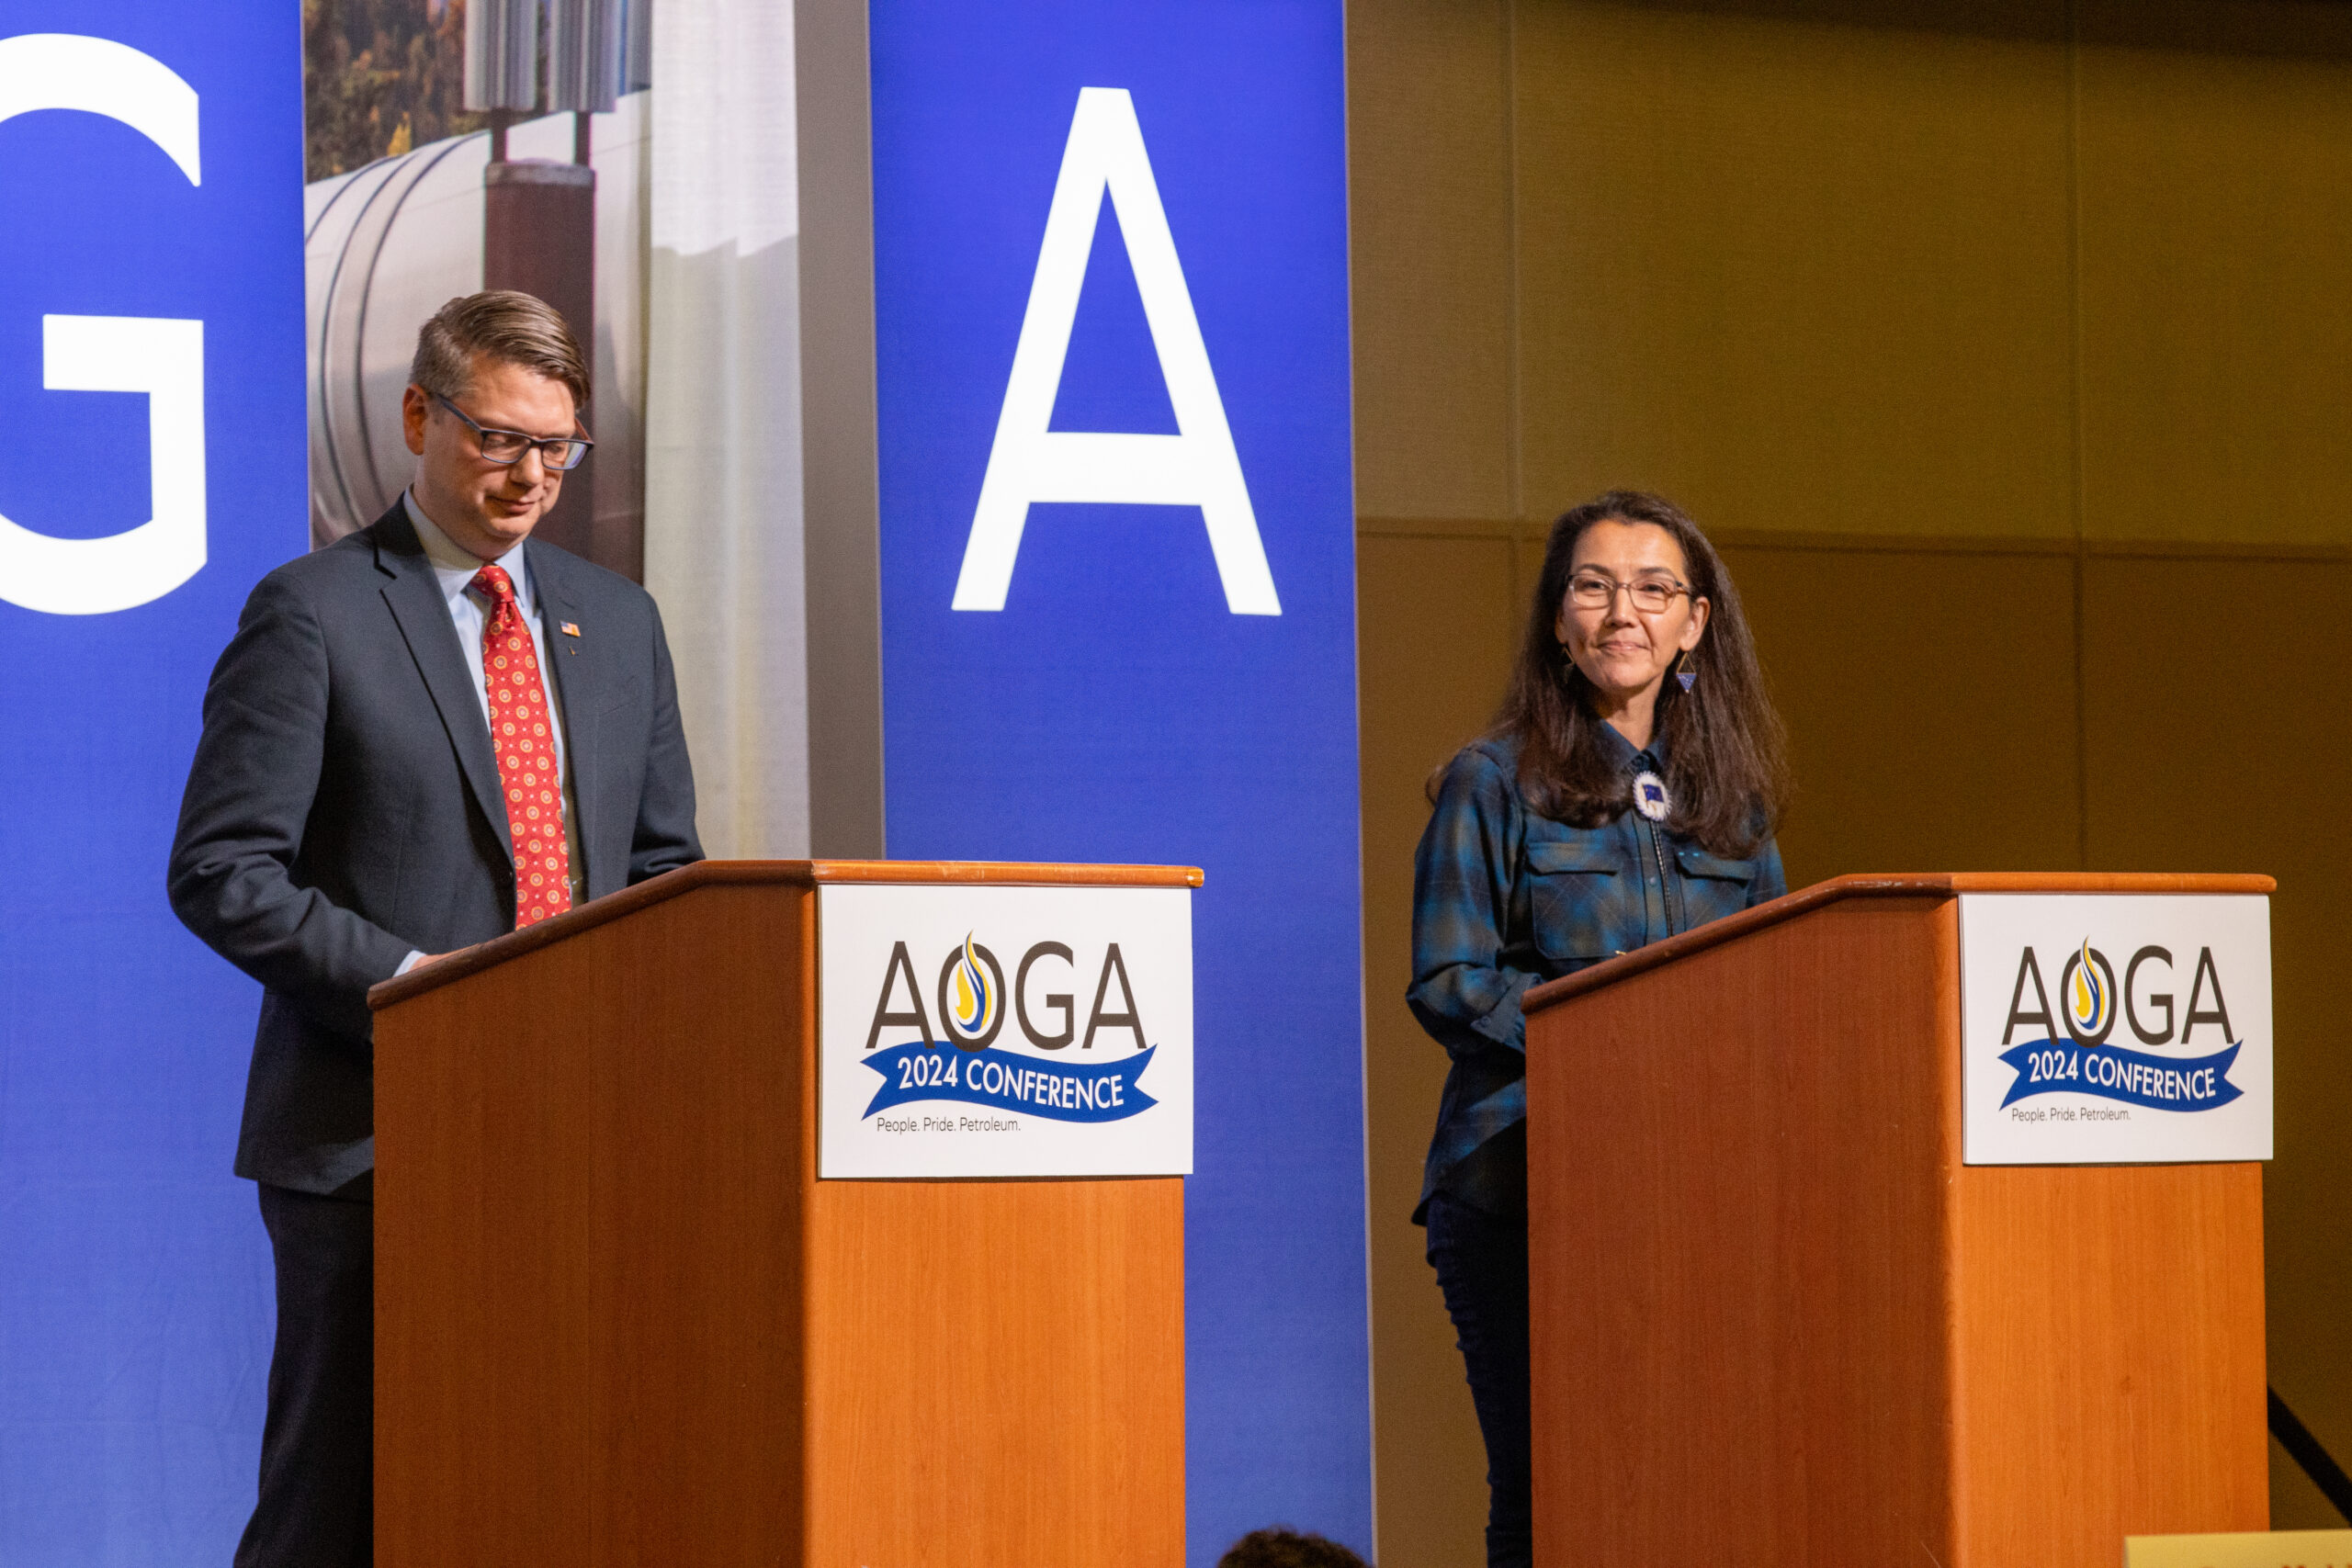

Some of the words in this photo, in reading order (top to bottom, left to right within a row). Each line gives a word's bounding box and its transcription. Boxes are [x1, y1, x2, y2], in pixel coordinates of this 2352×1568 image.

[0, 33, 208, 615] G
[952, 86, 1283, 616] A
[865, 941, 1148, 1053] AOGA
[2001, 945, 2234, 1048] AOGA
[898, 1055, 958, 1089] 2024
[966, 1059, 1125, 1111] CONFERENCE
[2029, 1050, 2078, 1083] 2024
[2085, 1055, 2216, 1100] CONFERENCE
[876, 1117, 920, 1134] People.
[923, 1117, 956, 1132] Pride.
[959, 1116, 1021, 1132] Petroleum.
[2011, 1108, 2048, 1124] People.
[2050, 1107, 2077, 1122] Pride.
[2080, 1106, 2132, 1121] Petroleum.
